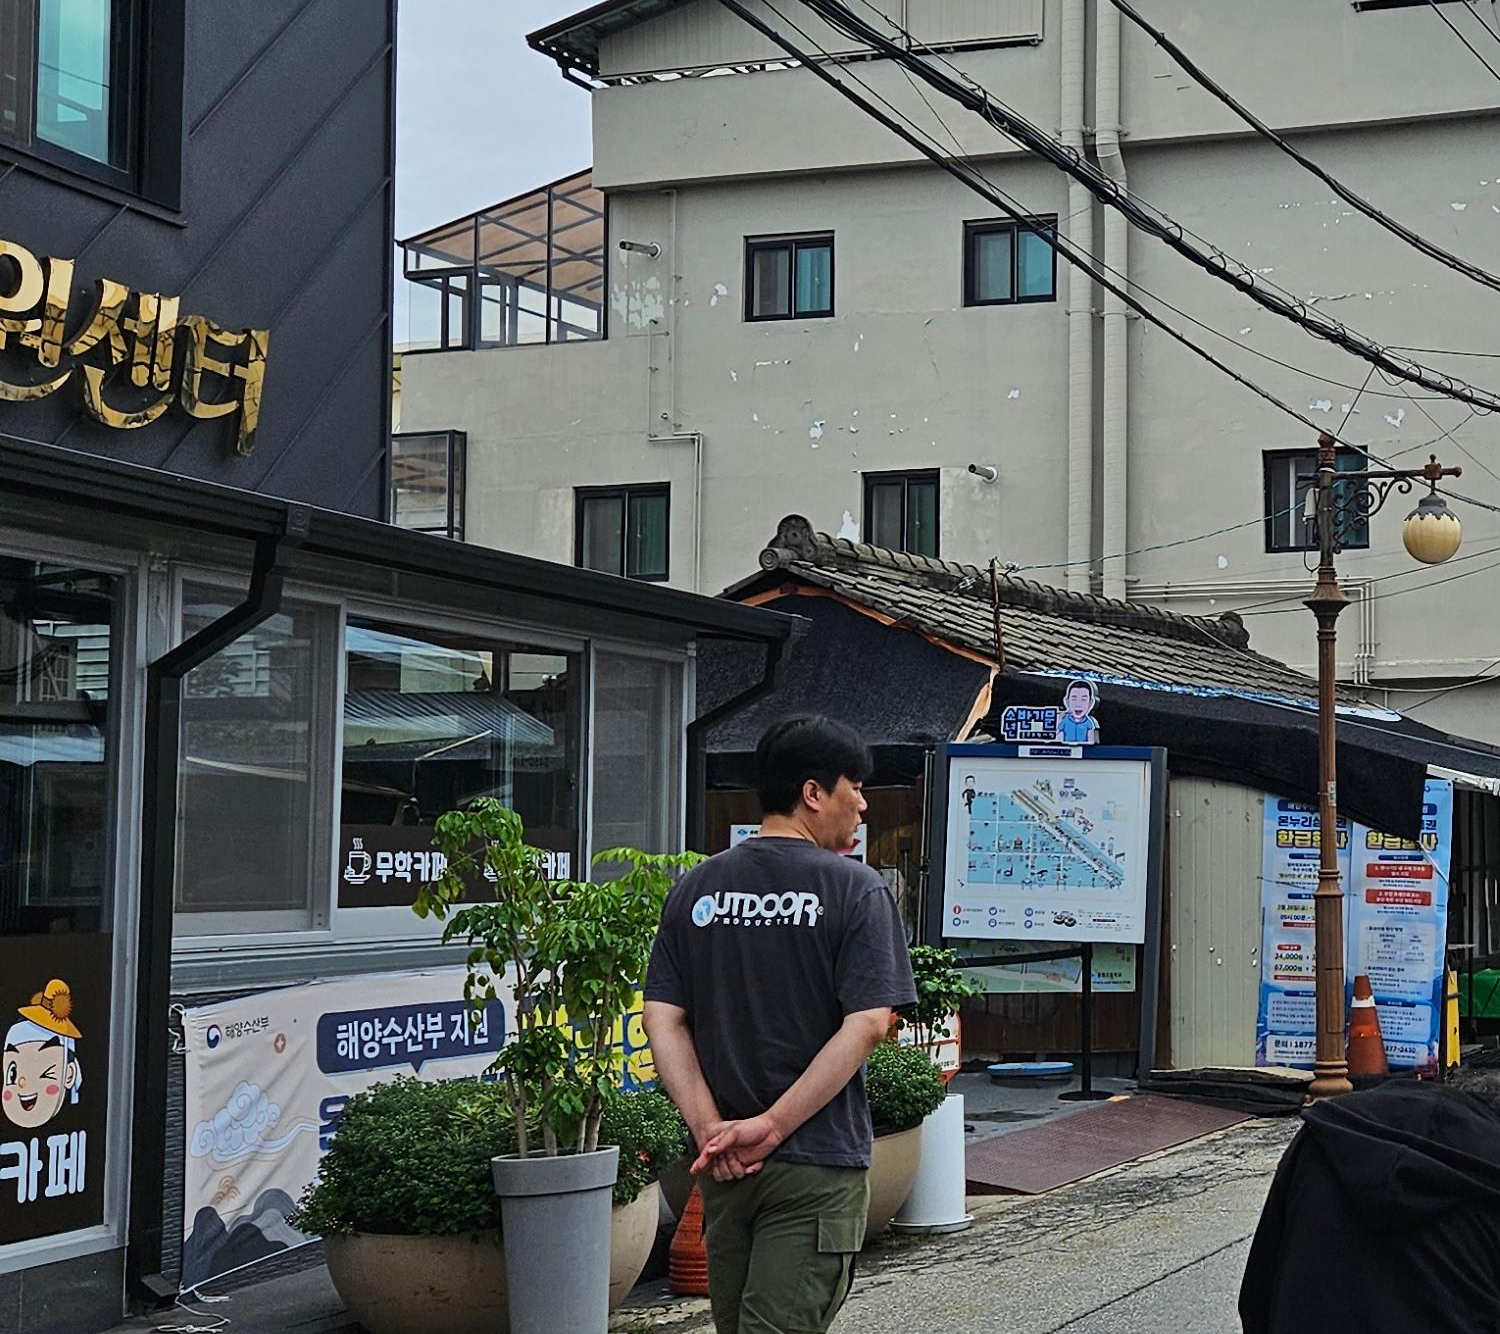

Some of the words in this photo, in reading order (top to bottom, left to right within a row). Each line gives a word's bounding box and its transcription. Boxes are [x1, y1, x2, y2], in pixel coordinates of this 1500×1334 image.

[1277, 815, 1348, 830] 온누리상권
[376, 851, 448, 883] 무학카페
[692, 891, 820, 927] OUTDOOR
[713, 917, 790, 927] PRODUCTS
[225, 1017, 270, 1038] 해양수산부
[336, 1017, 446, 1060] 해양수산부
[450, 1007, 489, 1047] 지원
